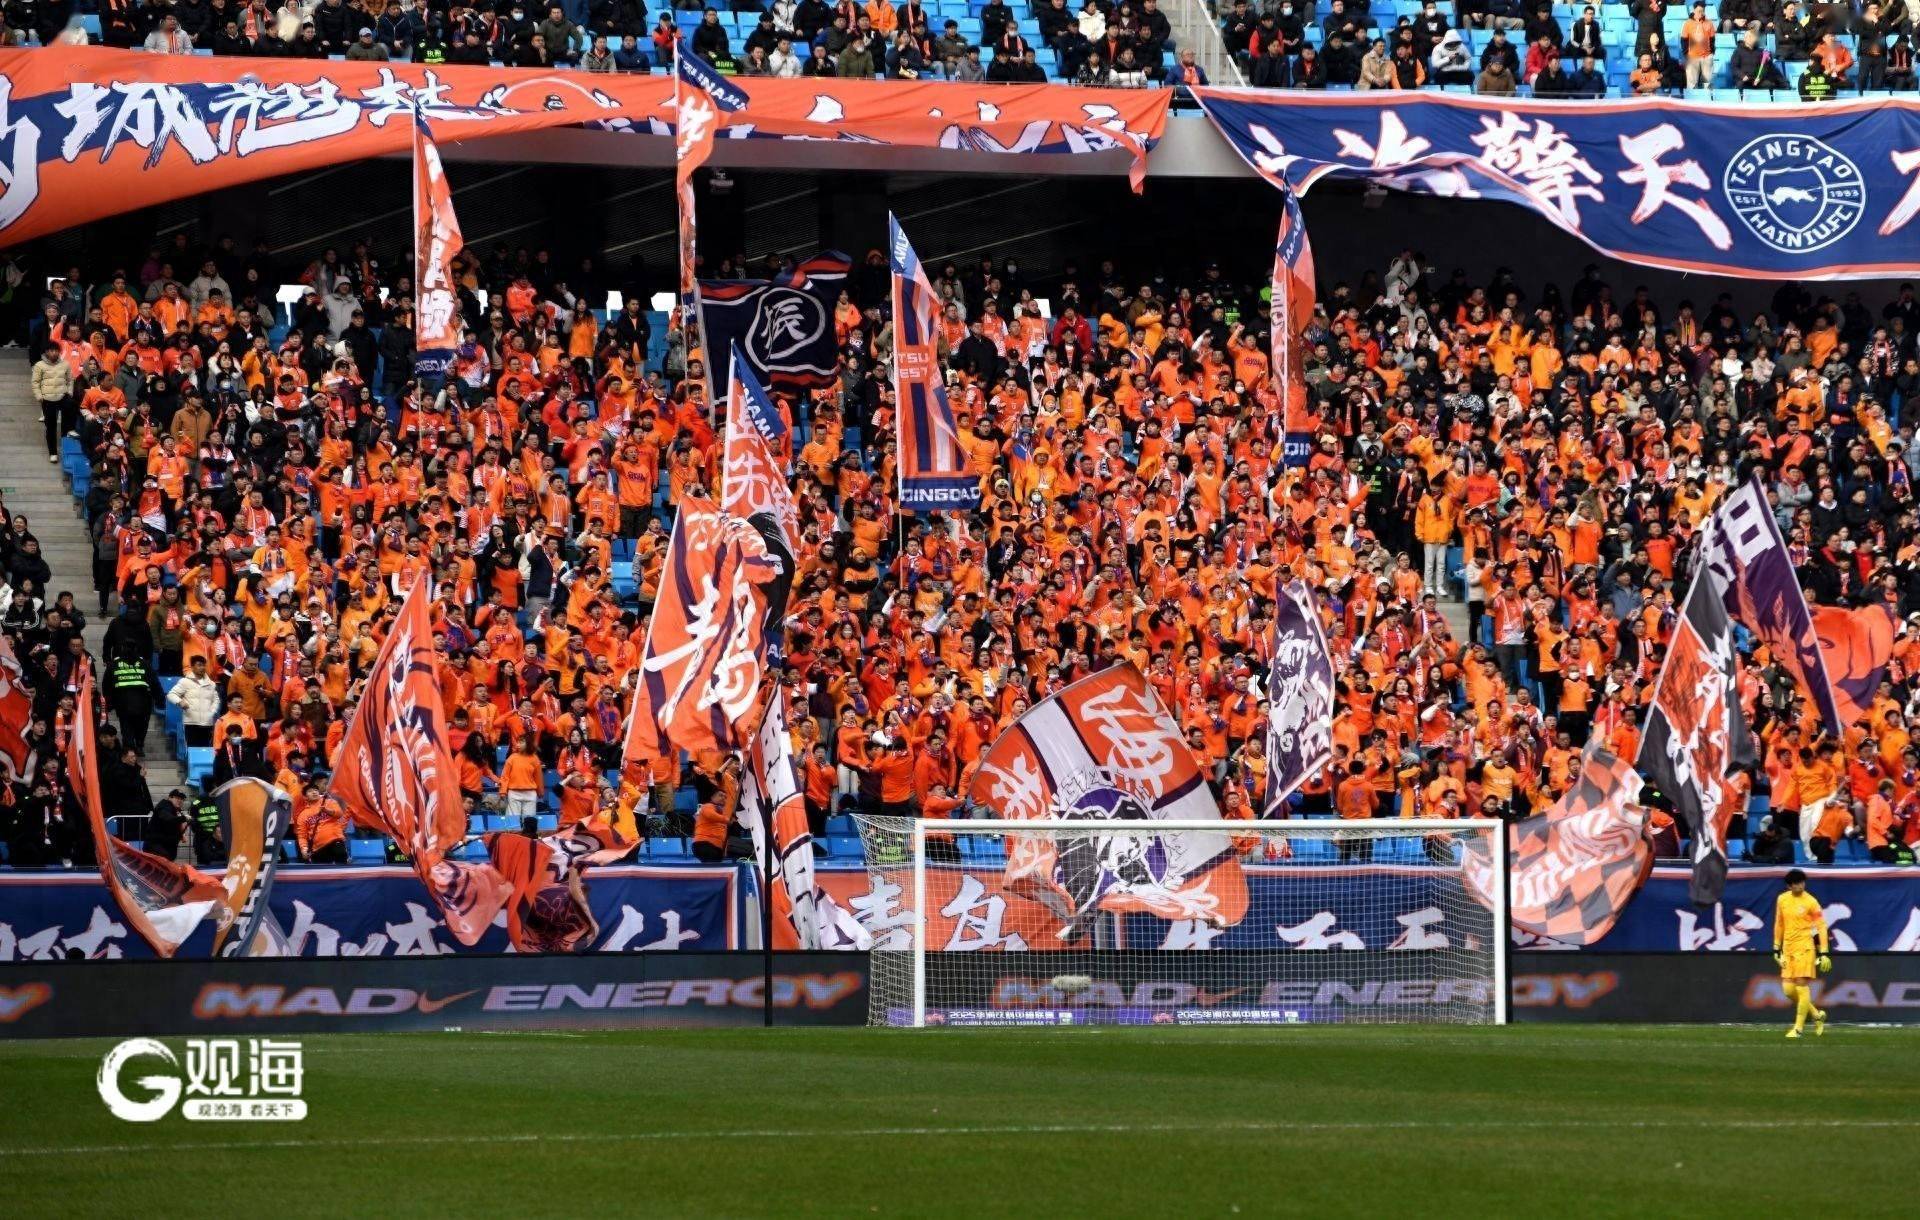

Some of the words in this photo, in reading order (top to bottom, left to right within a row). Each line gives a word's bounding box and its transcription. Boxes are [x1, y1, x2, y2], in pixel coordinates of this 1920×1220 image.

[1730, 140, 1853, 185] TSINGTAO
[1735, 195, 1763, 206] EST.
[1829, 189, 1860, 199] 1993
[193, 982, 419, 1018] MAD
[482, 972, 862, 1011] ENERGY
